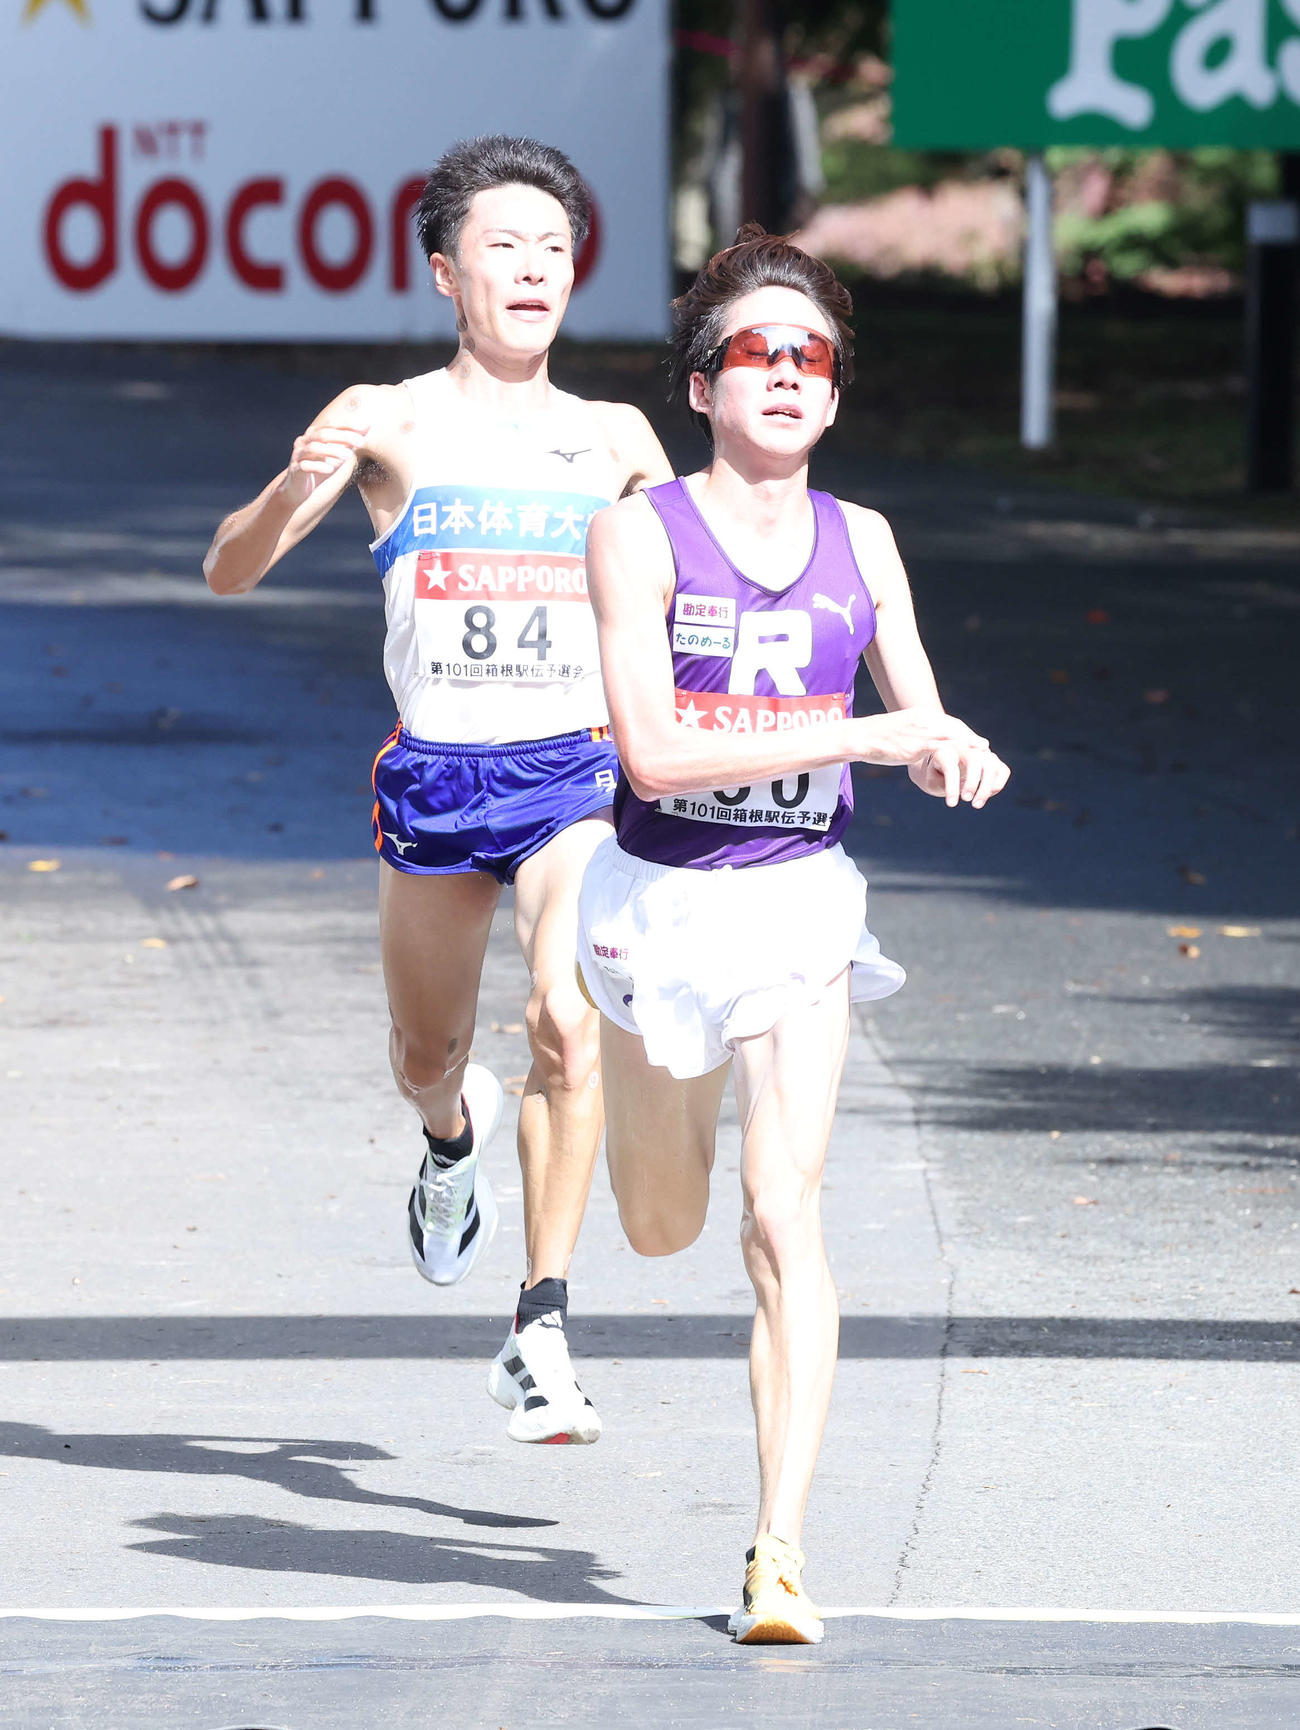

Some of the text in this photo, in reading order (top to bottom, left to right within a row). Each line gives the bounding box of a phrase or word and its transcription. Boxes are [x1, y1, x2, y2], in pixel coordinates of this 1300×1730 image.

[131, 122, 206, 160] NTT
[42, 124, 604, 292] doco
[413, 498, 589, 540] 日本体育大
[458, 564, 588, 594] SAPPORO
[462, 605, 552, 661] 84
[676, 632, 731, 649] たのめーる
[431, 661, 584, 679] 第101回箱根駅伝予選会
[729, 610, 813, 696] R
[673, 798, 833, 827] 第101回箱根駅伝予選
